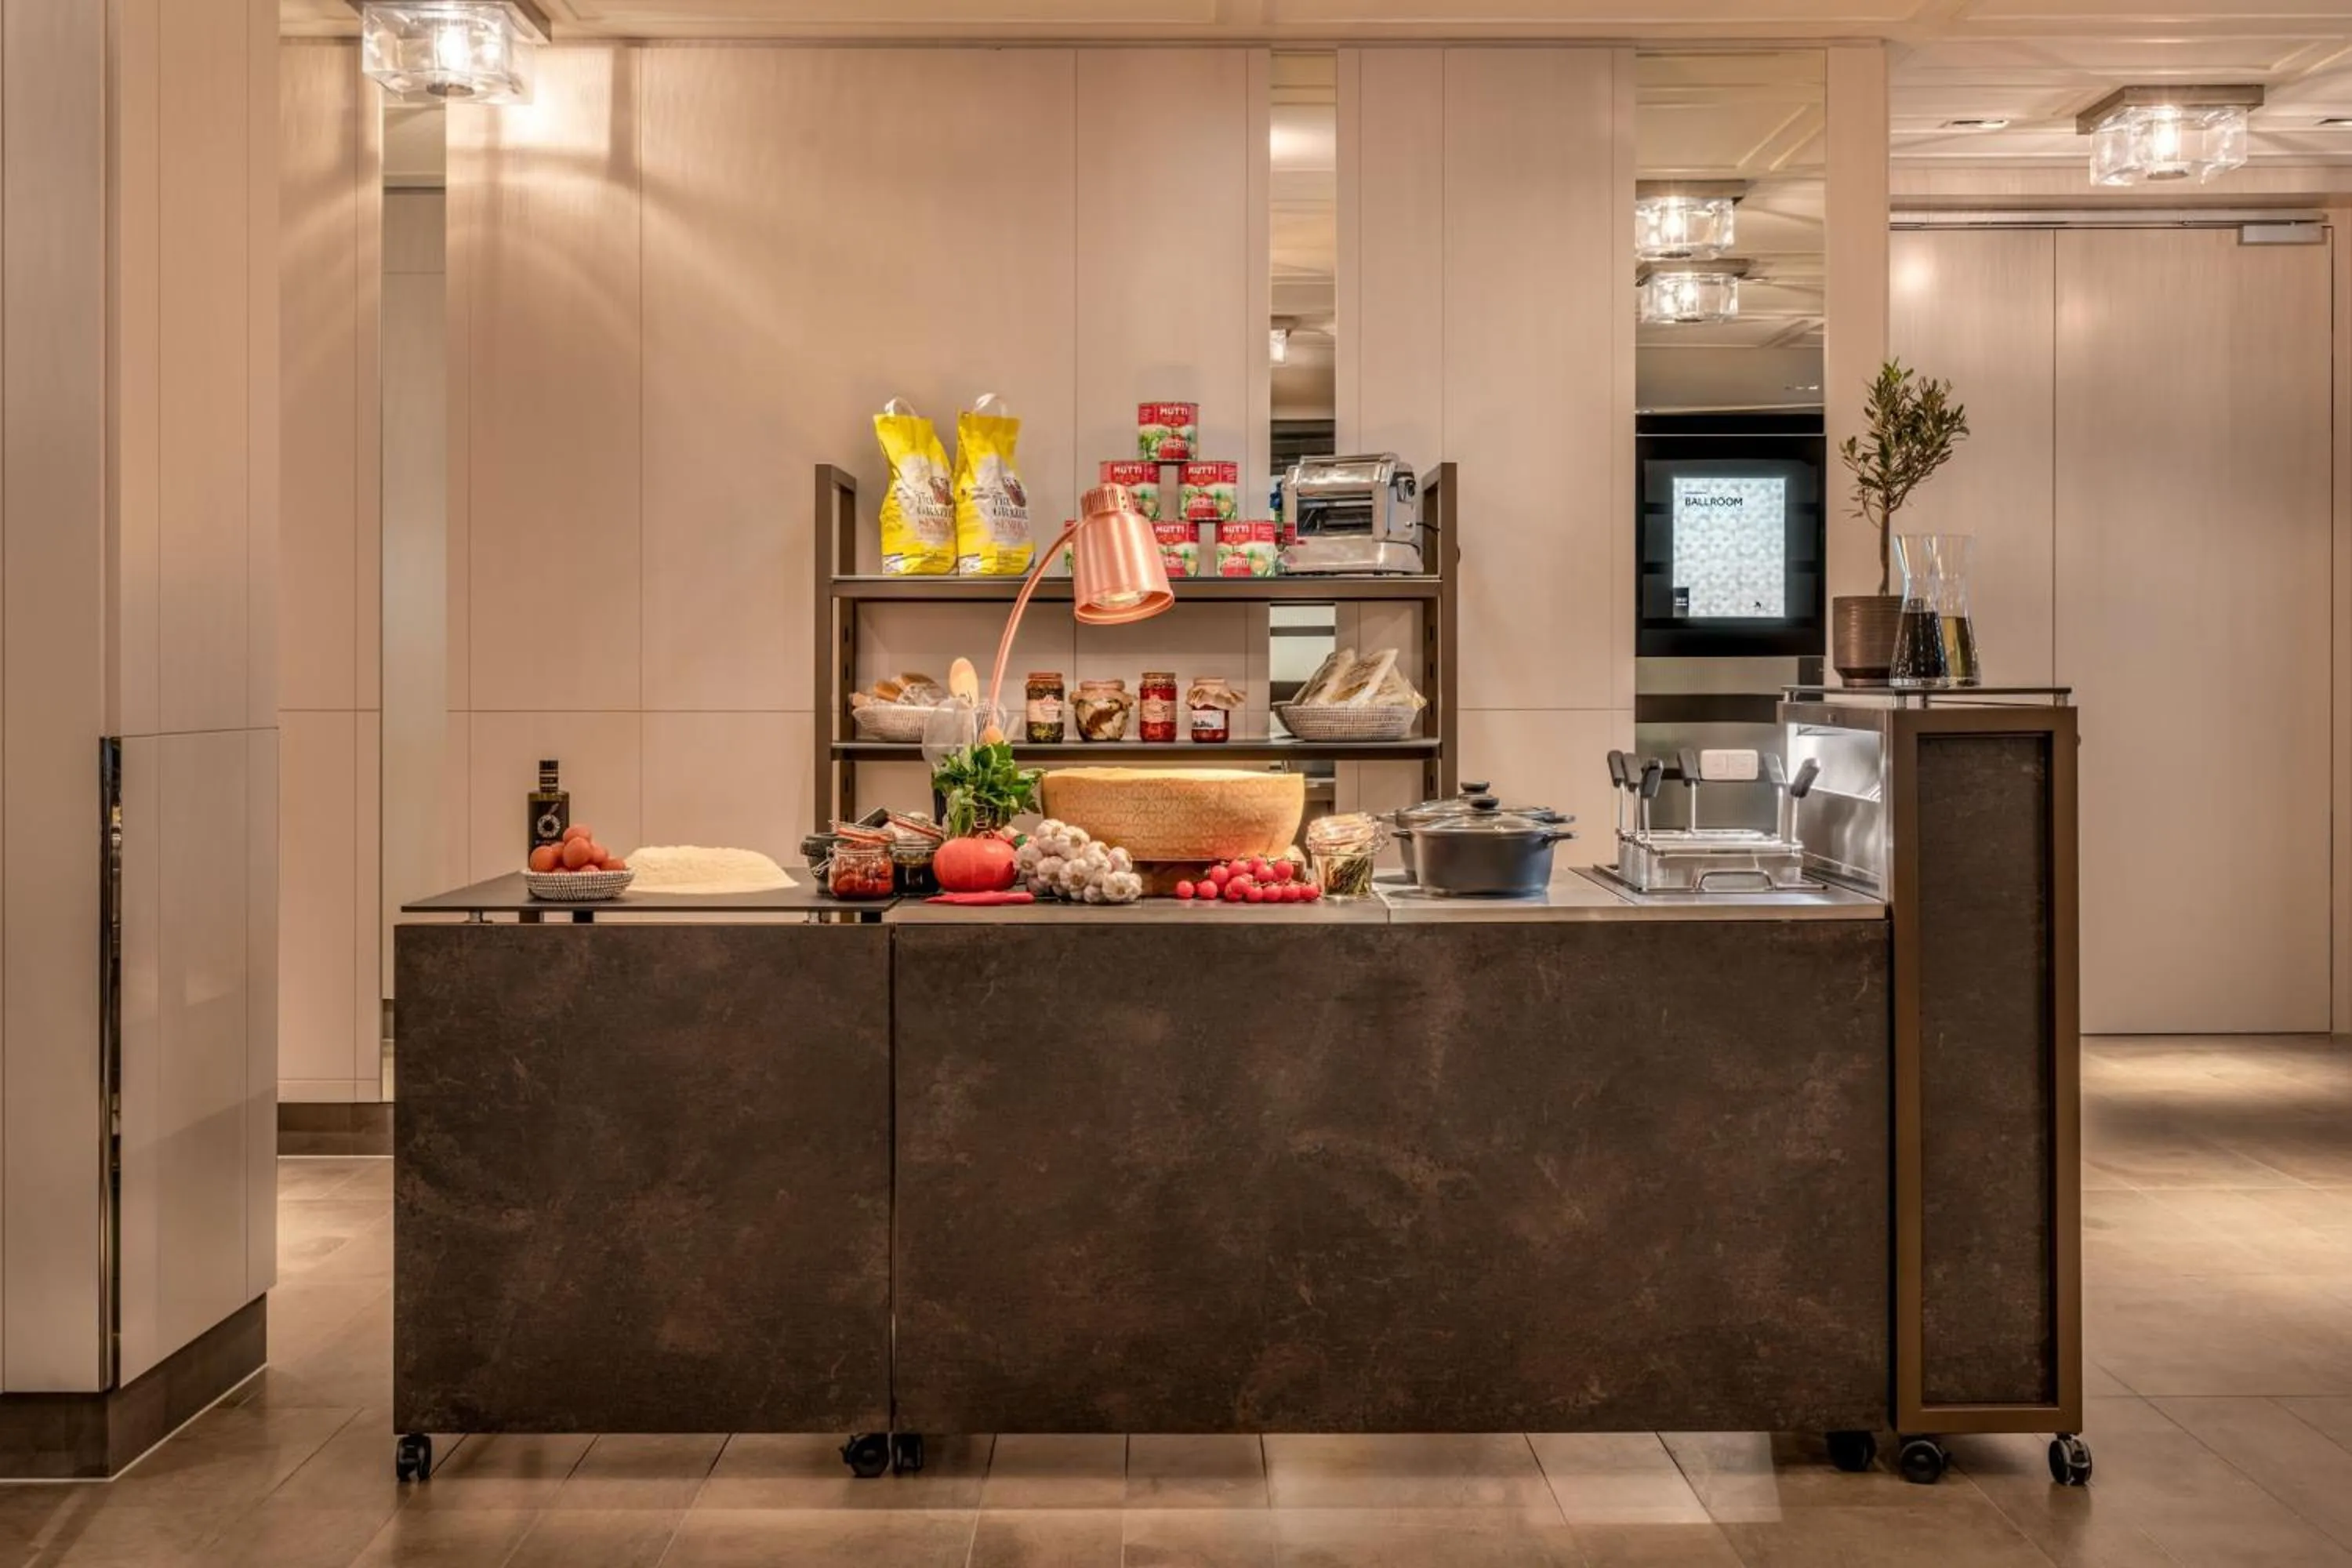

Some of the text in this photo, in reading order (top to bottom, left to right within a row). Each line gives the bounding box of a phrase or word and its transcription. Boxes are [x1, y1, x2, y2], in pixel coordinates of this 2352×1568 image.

[1160, 406, 1188, 415] MUTTI
[1113, 465, 1142, 474] MUTTI
[1188, 465, 1217, 475] MUTTI
[1685, 496, 1744, 507] BALLROOM
[1156, 525, 1185, 534] MUTTI
[1222, 524, 1249, 534] MUTTI
